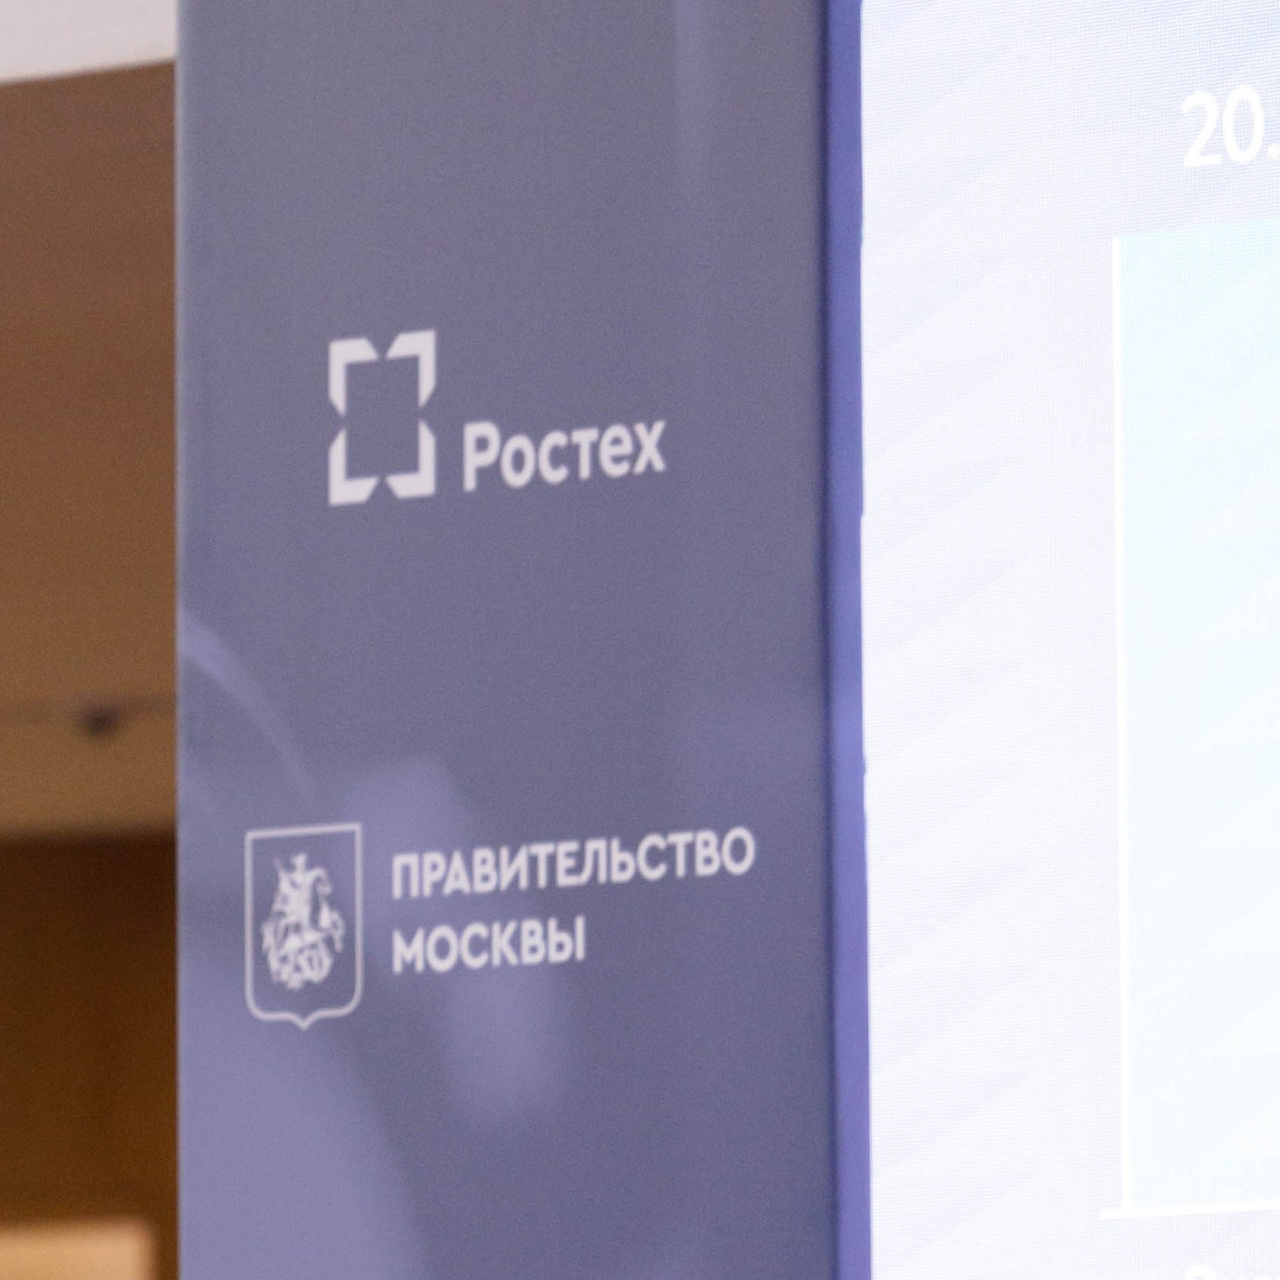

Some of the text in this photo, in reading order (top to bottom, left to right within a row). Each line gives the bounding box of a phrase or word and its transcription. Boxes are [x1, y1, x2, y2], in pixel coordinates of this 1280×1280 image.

[463, 419, 666, 493] Ростех
[392, 826, 755, 899] ПРАВИТЕЛЬСТВО
[392, 915, 586, 974] МОСКВЫ
